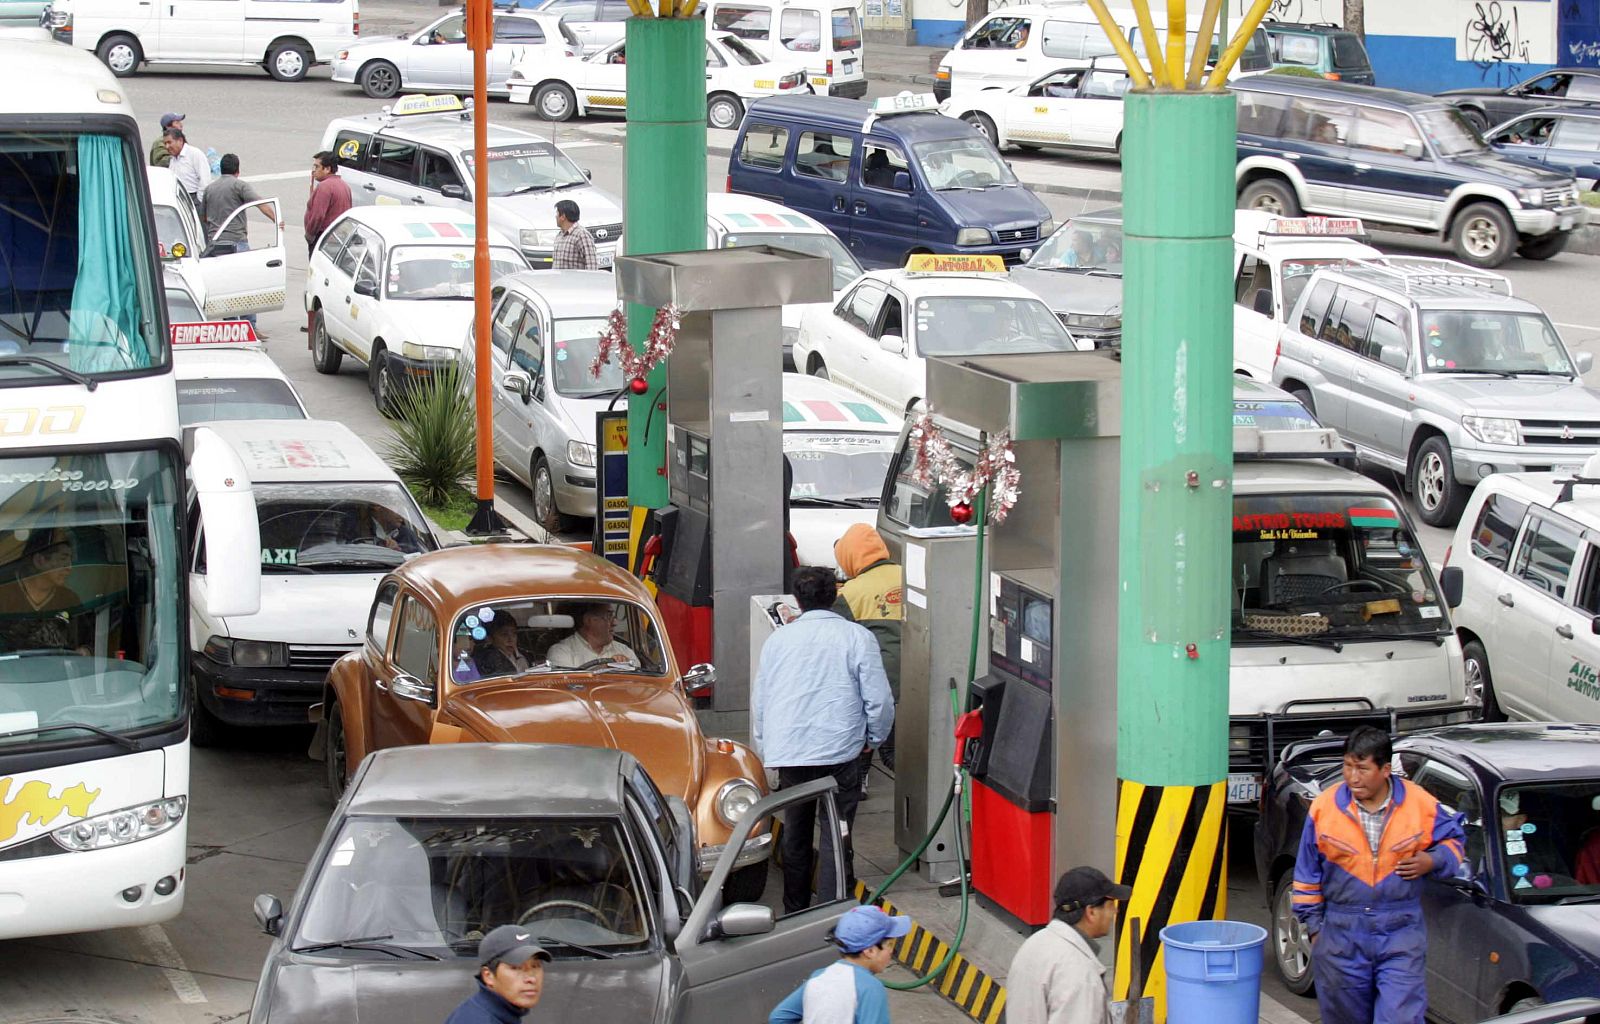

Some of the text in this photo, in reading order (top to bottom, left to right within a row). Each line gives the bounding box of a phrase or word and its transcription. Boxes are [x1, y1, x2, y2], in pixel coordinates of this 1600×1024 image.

[895, 96, 924, 109] 945
[1308, 216, 1328, 233] 334
[934, 257, 985, 271] LITORAL
[175, 324, 249, 343] EMPERADOR
[607, 521, 628, 530] GASOL
[1233, 513, 1345, 530] ASTRID TOURS
[608, 543, 627, 551] DIESEL
[261, 549, 297, 564] AXI
